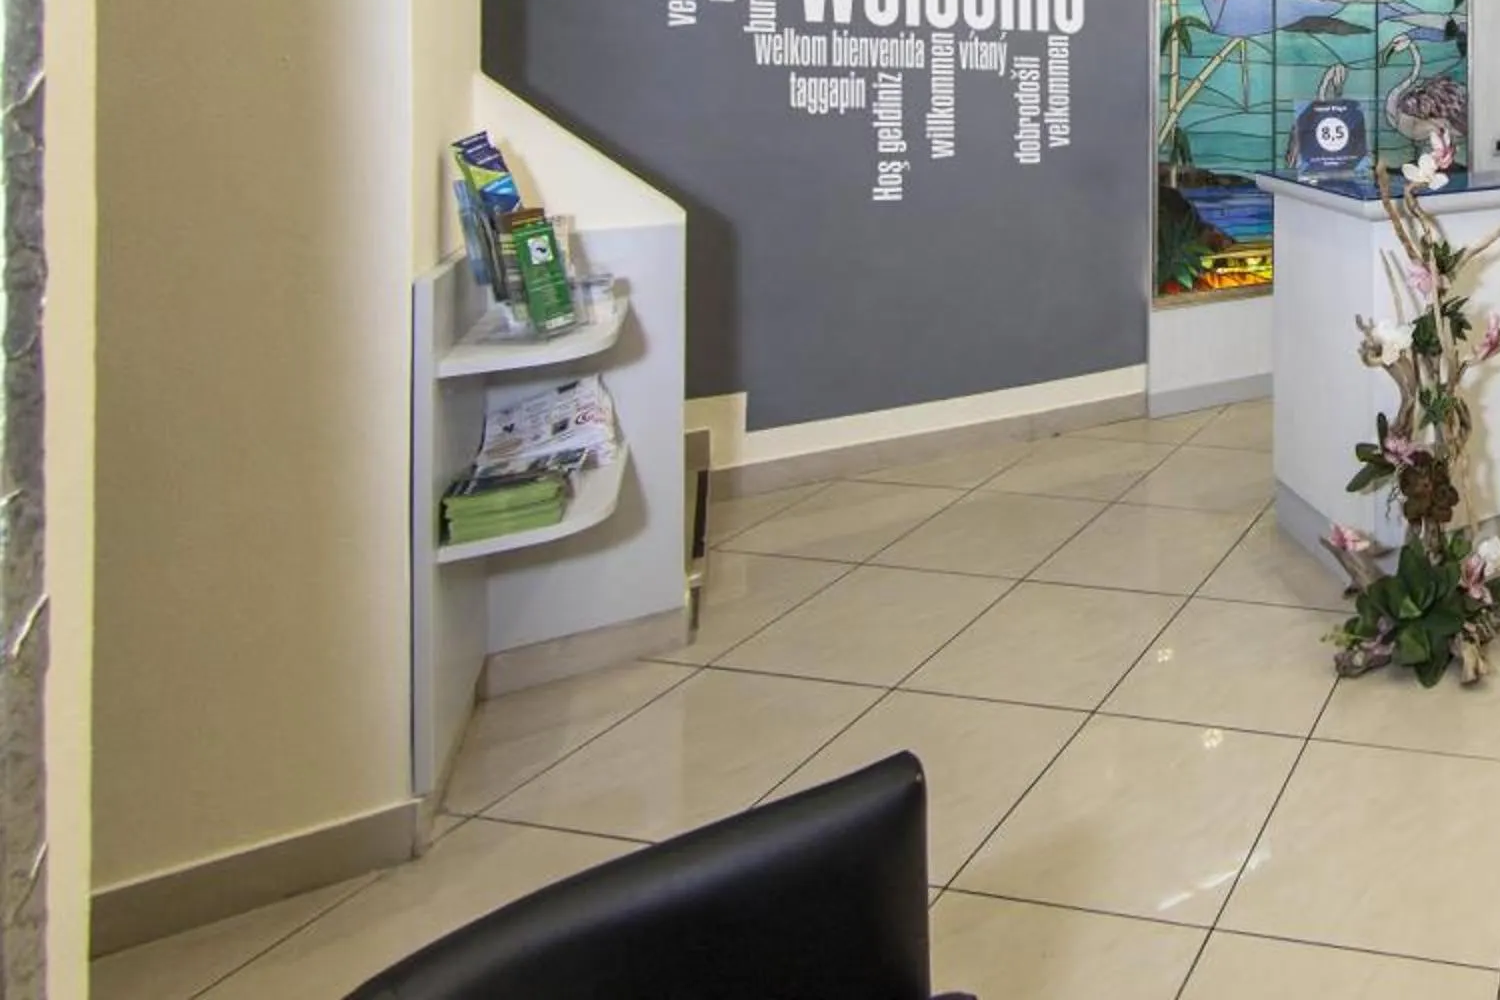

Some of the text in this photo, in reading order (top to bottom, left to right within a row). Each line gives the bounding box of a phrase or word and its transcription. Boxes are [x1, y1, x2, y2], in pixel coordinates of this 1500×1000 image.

[753, 27, 926, 69] welkom bienvenida
[958, 30, 1008, 77] vítaný
[789, 71, 867, 115] taggapin
[925, 32, 955, 159] willkommen
[1010, 56, 1041, 164] dobrodošli
[1043, 35, 1071, 149] velkommen
[871, 71, 911, 202] Hoş geldiniz
[1321, 125, 1345, 142] 8,5
